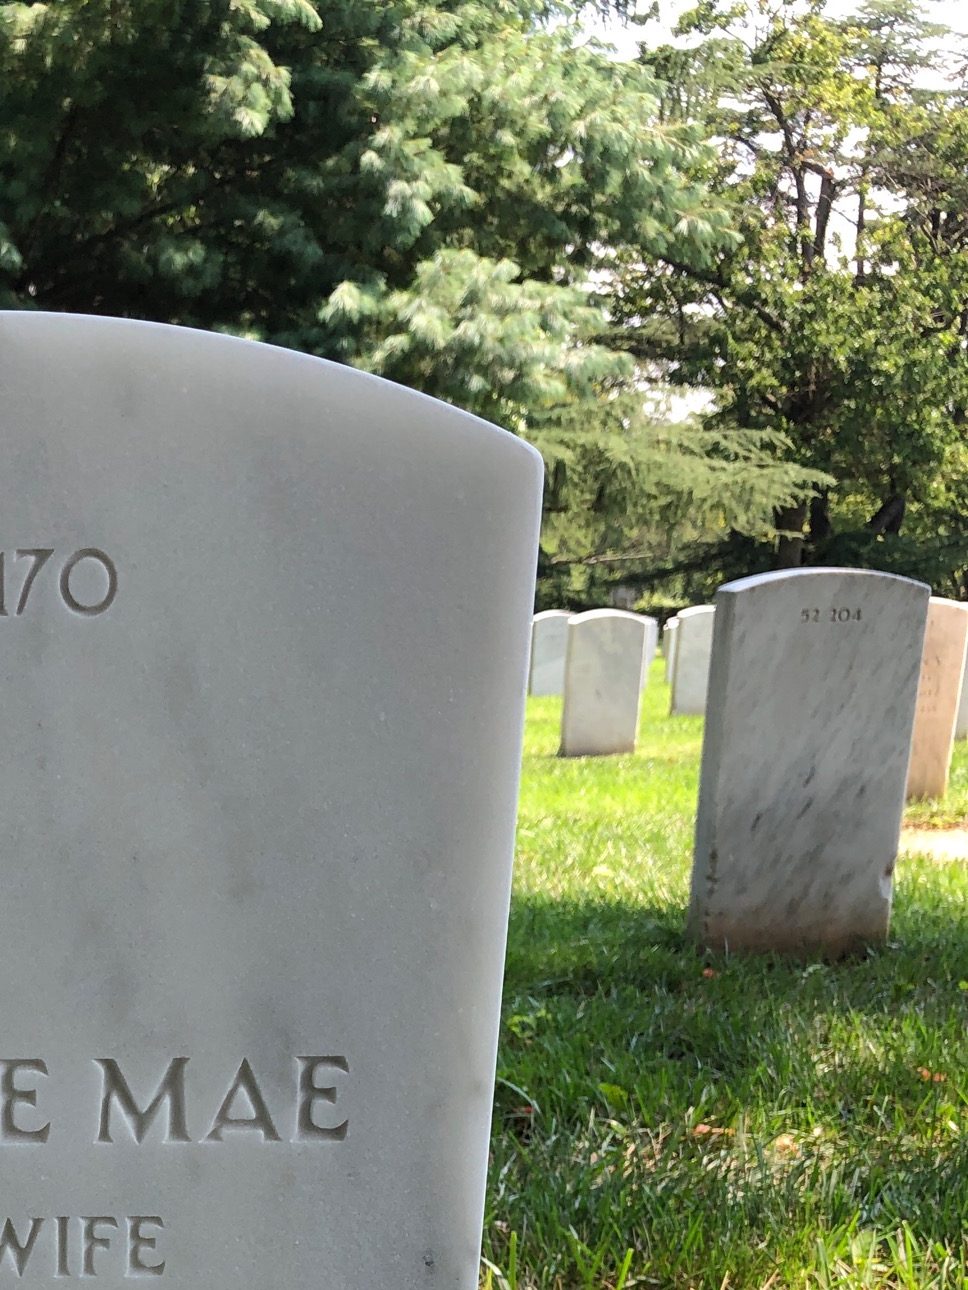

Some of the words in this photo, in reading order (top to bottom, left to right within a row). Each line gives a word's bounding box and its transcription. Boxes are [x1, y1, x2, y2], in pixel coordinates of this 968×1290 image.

[800, 607, 820, 623] 52
[830, 606, 862, 623] 204
[92, 1055, 350, 1145] MAE
